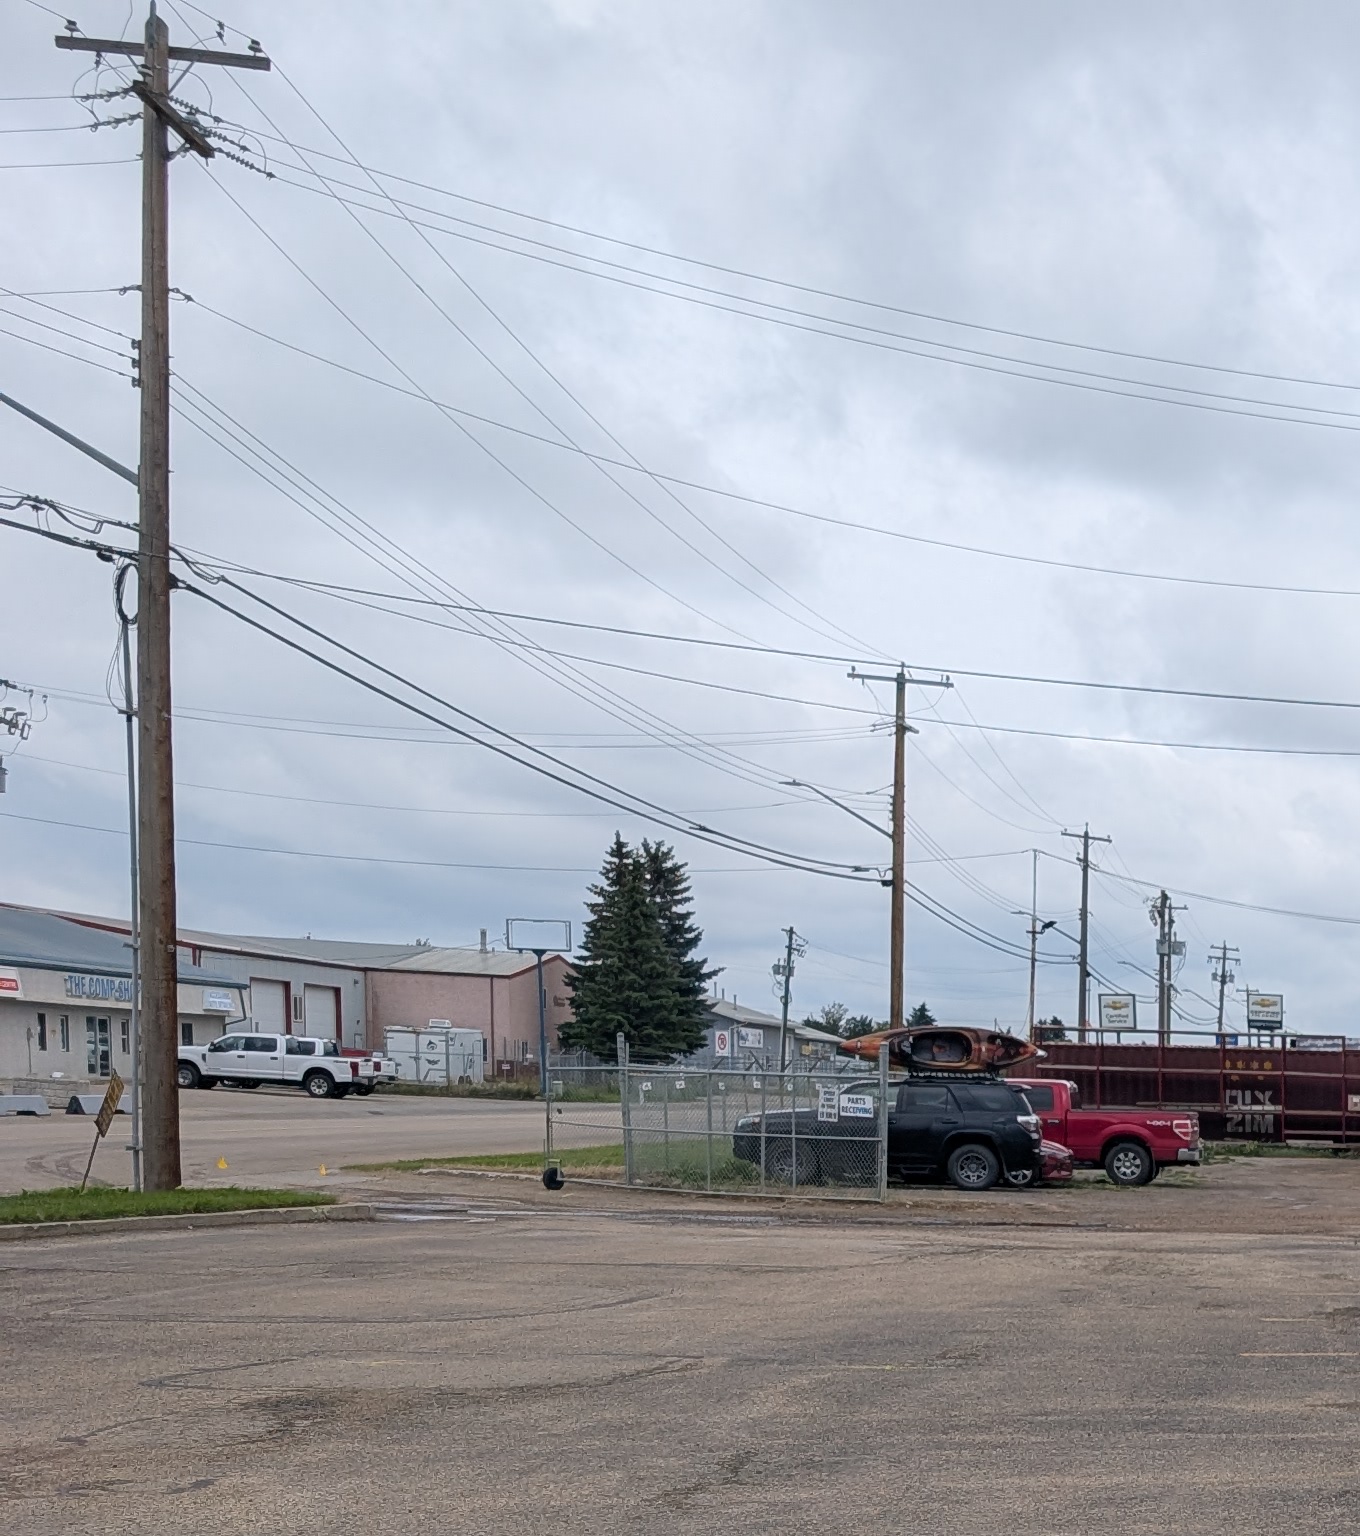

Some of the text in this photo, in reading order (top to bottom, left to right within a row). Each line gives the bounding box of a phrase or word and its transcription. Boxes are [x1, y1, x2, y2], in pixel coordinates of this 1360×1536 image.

[68, 976, 86, 995] THE
[848, 1097, 866, 1105] PARTS
[842, 1106, 872, 1114] RECEIVING
